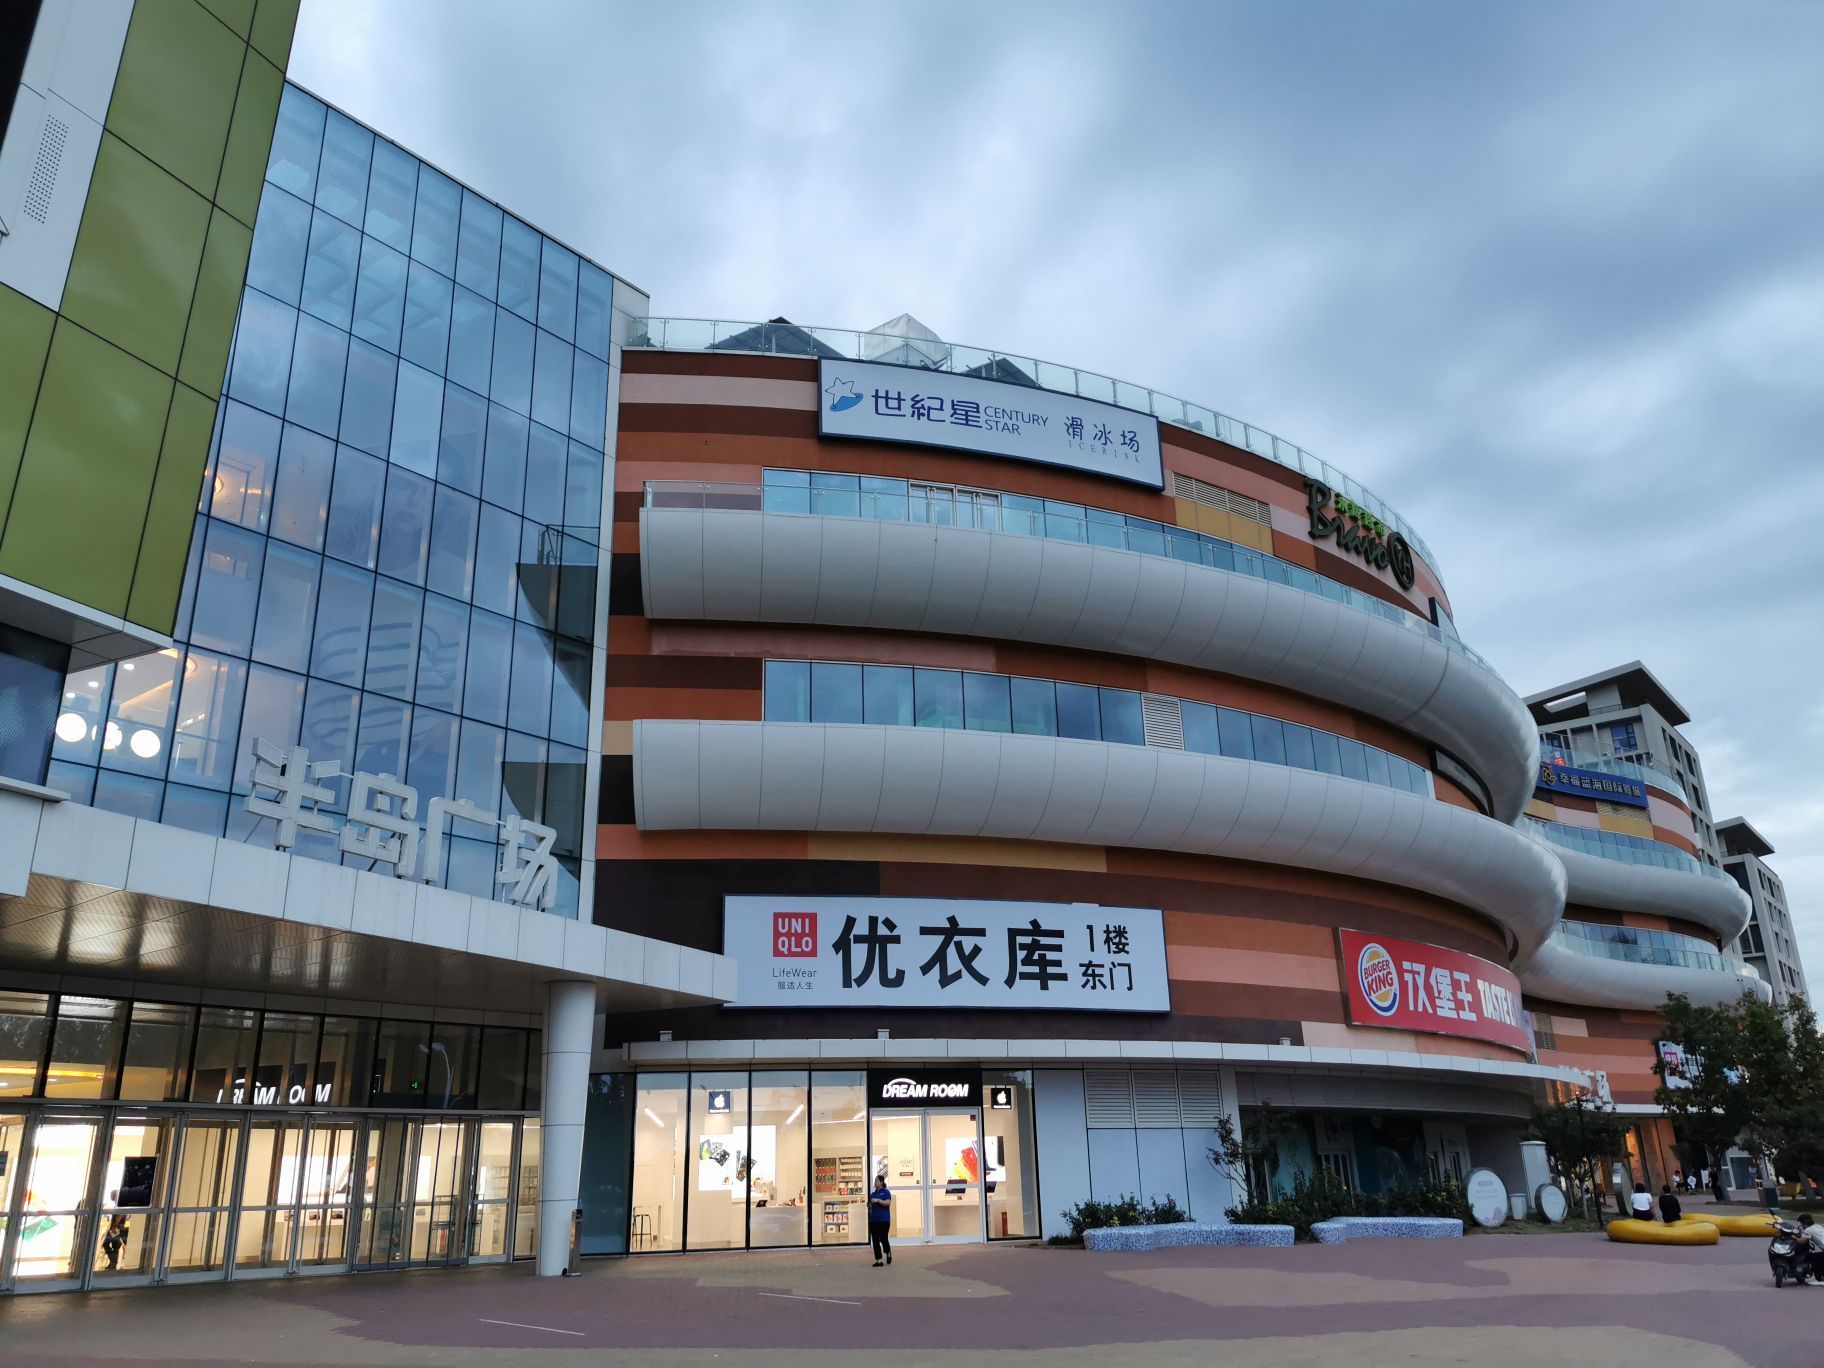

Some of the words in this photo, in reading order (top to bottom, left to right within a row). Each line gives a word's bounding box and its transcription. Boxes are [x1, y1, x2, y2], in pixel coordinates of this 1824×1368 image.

[984, 405, 1049, 428] CENTURY
[985, 421, 1021, 436] STAR
[1064, 416, 1140, 453] 滑冰场
[243, 736, 558, 908] 半岛广场
[778, 917, 810, 934] UNI
[777, 936, 813, 955] QLO
[1086, 924, 1130, 955] 1楼
[831, 914, 1069, 991] 优衣库
[772, 967, 819, 978] LifeWear
[1079, 960, 1133, 991] 东门
[1363, 960, 1391, 980] BURGER
[777, 981, 815, 990] 服适人生
[1367, 971, 1394, 997] KING
[1401, 960, 1478, 1022] 汉堡王
[882, 1082, 928, 1098] DREAM
[929, 1083, 969, 1098] ROOM
